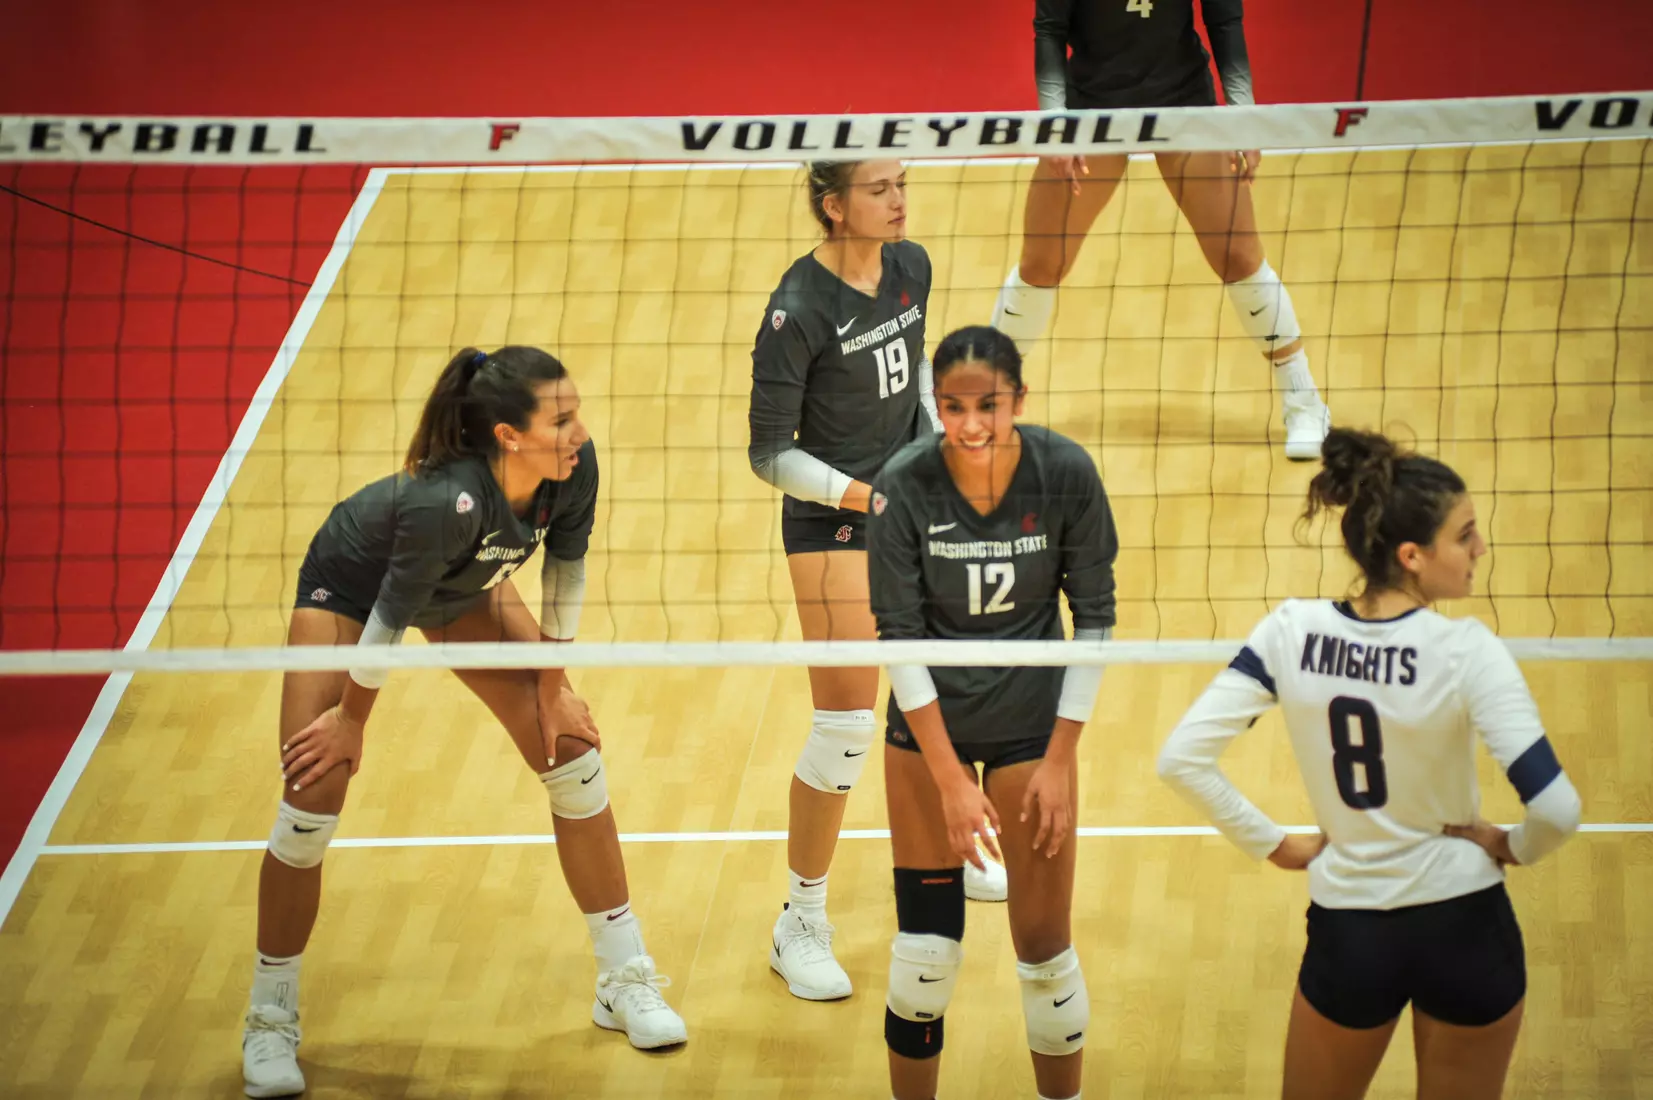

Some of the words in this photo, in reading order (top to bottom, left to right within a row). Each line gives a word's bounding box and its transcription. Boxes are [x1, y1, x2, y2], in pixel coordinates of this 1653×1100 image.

[681, 115, 1171, 151] VOLLEYBALL
[1333, 107, 1368, 137] F
[1535, 98, 1653, 131] VO
[488, 123, 521, 151] F
[841, 319, 900, 355] WASHINGTON
[899, 304, 923, 329] STATE
[873, 337, 909, 399] 19
[928, 540, 1012, 559] WASHINGTON
[1013, 534, 1047, 555] STATE
[966, 562, 1015, 616] 12
[1300, 632, 1418, 686] KNIGHTS
[1329, 695, 1388, 811] 8
